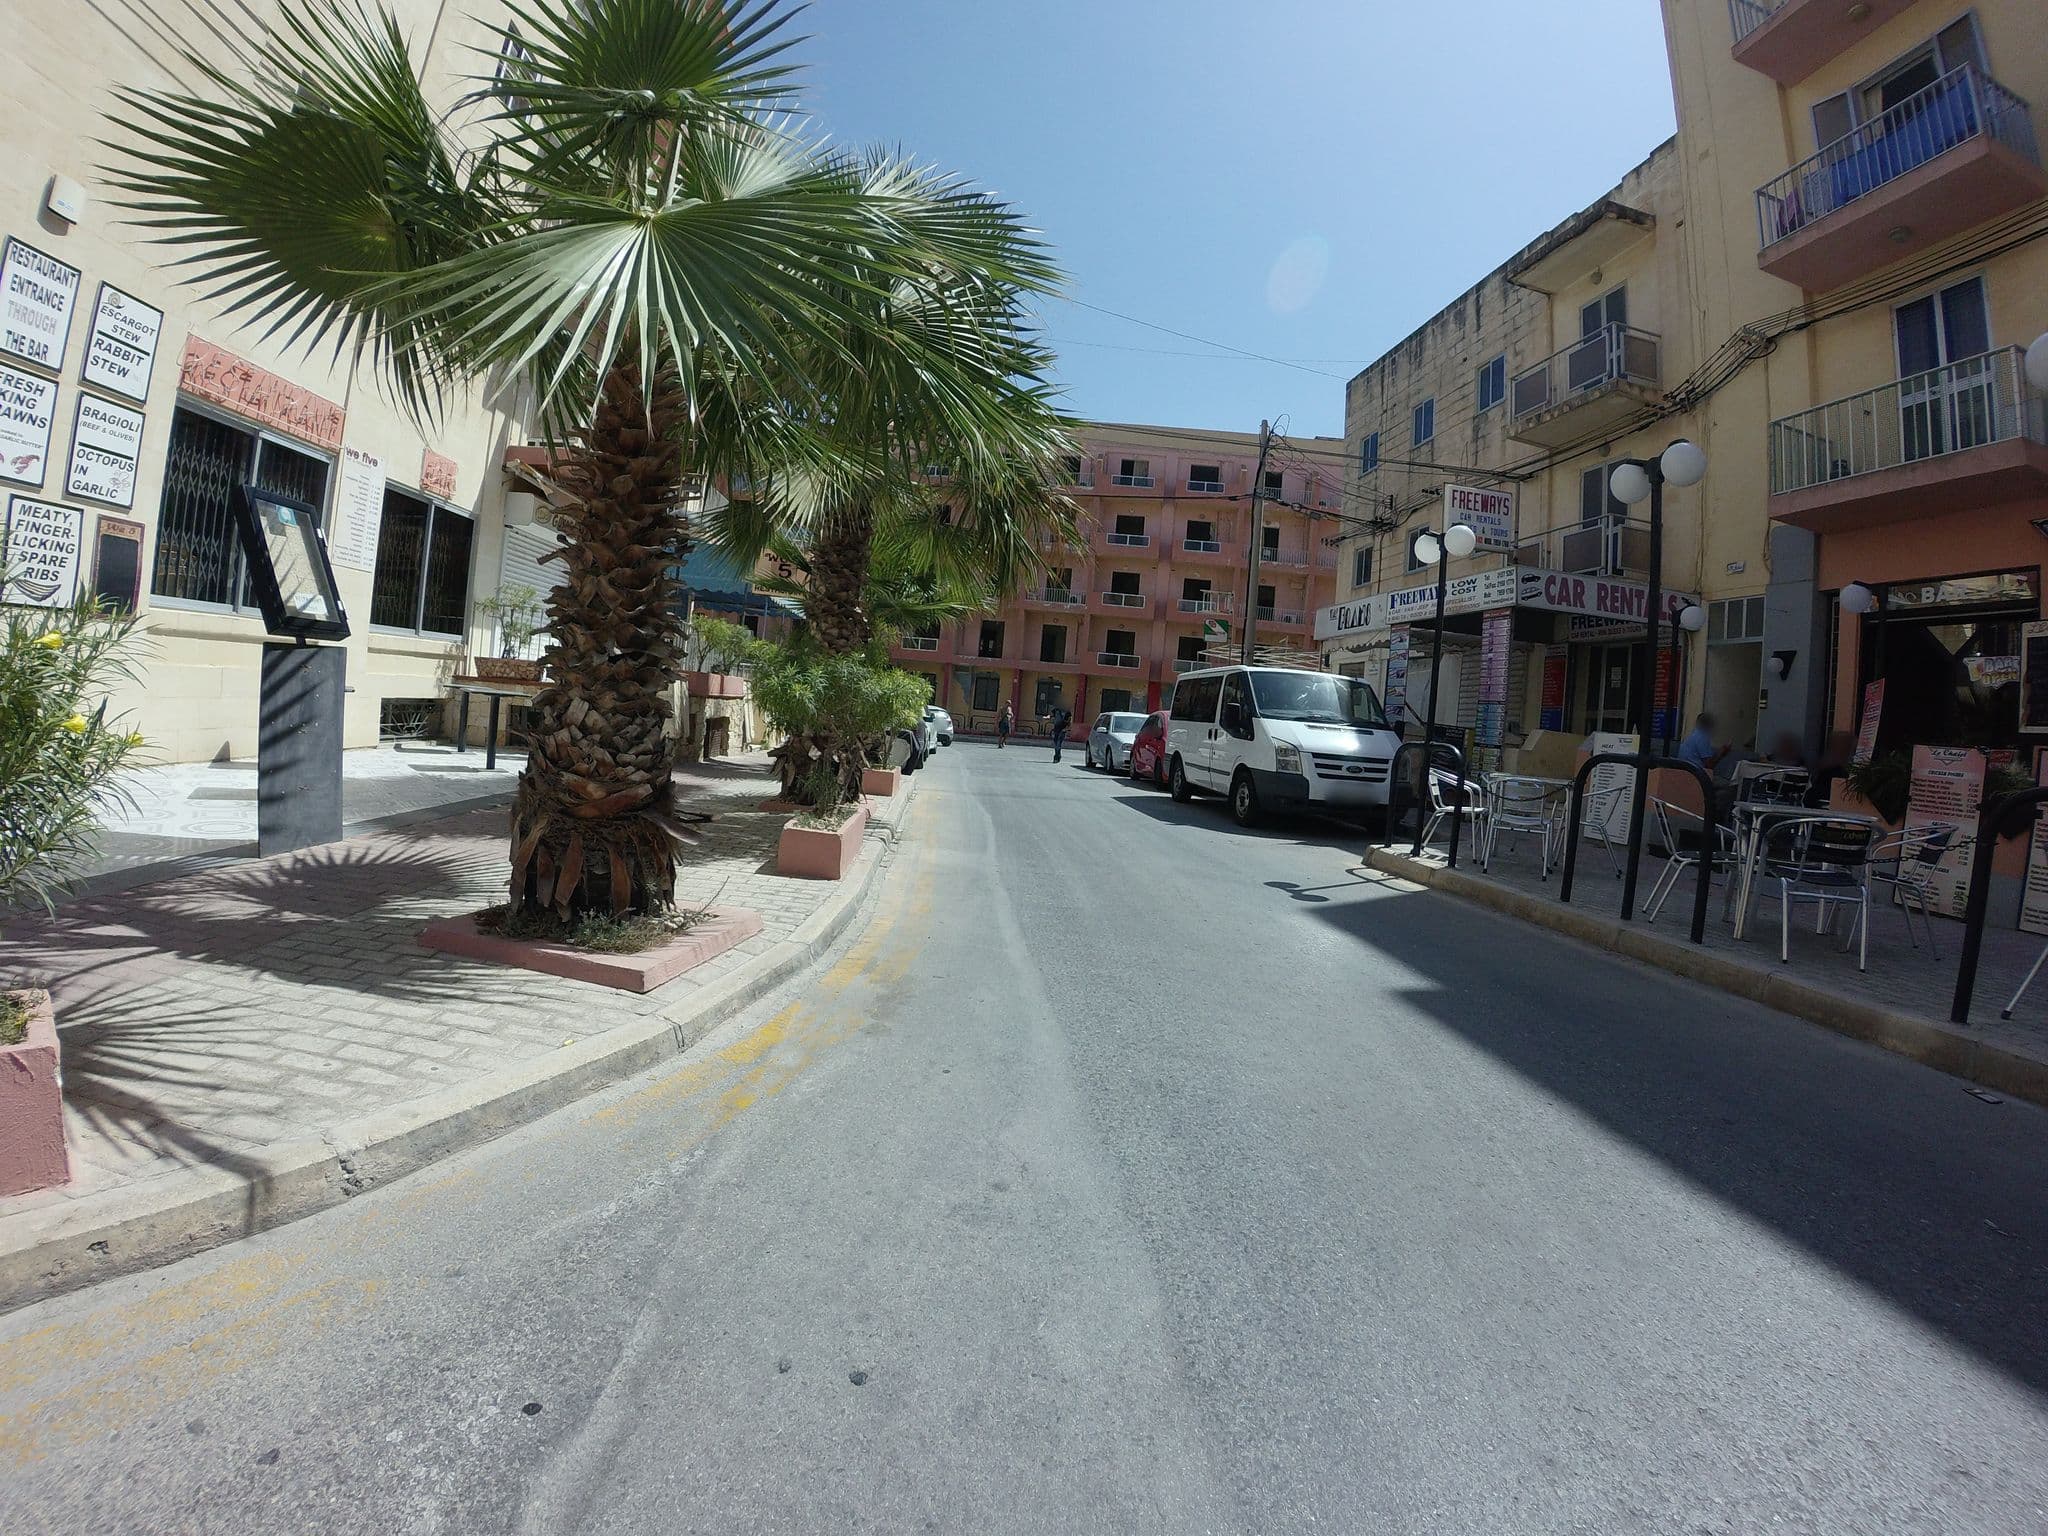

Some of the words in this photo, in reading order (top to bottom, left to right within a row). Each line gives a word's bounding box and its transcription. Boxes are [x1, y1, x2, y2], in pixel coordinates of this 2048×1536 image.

[9, 242, 77, 289] RESTAURANT
[10, 273, 65, 312] ENTRANCE
[7, 300, 57, 336] THROUGH
[100, 305, 156, 337] ESCARGOT
[111, 324, 141, 343] STEW
[5, 330, 26, 353] THE
[27, 338, 49, 362] BAR
[93, 338, 144, 367] RABBIT
[90, 355, 130, 378] STEW
[0, 388, 37, 410] KING
[0, 404, 48, 429] AWNS
[82, 406, 140, 433] BRAGIOLI
[80, 420, 100, 431] (BEEF
[109, 430, 135, 442] OLIVES)
[76, 449, 134, 472] OCTOPUS
[345, 446, 359, 459] we
[362, 451, 379, 468] five
[74, 463, 89, 476] IN
[72, 480, 118, 499] GARLIC
[1452, 489, 1510, 516] FREEWAYS
[18, 504, 73, 526] MEATY,
[1460, 512, 1471, 520] CAR
[1476, 515, 1501, 526] RENTALS
[15, 519, 75, 539] FINGER-
[1491, 528, 1509, 538] TOURS
[12, 534, 75, 554] LICKING
[18, 551, 69, 568] SPARE
[779, 563, 792, 578] 5
[24, 567, 60, 581] RIBS
[1451, 578, 1478, 589] LOW
[1390, 584, 1447, 609] FREEWAY
[1451, 586, 1478, 596] COST
[1544, 574, 1586, 609] CAR
